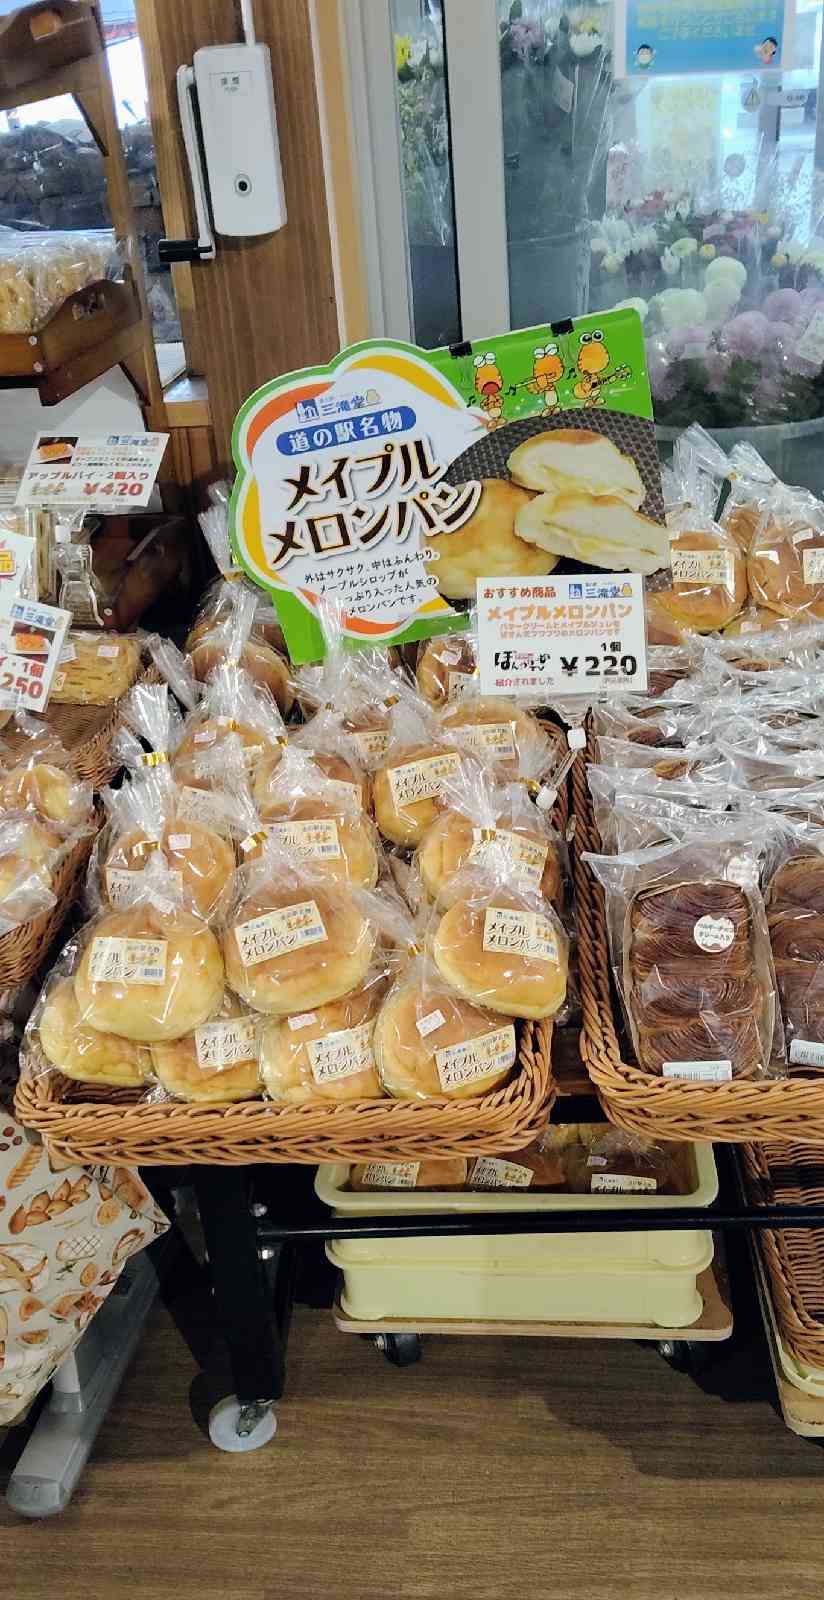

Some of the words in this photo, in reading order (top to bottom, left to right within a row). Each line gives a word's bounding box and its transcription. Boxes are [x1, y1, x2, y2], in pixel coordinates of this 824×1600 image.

[288, 410, 404, 453] 道の駅名物
[284, 440, 441, 511] メイプル
[269, 484, 482, 564] メロンパン
[345, 577, 437, 602] っぷり入った人気の
[483, 586, 557, 599] おすすめ商品
[487, 602, 632, 621] メイプルメロンパン
[600, 641, 621, 652] 1個
[560, 655, 637, 677] ¥220
[241, 927, 277, 946] メイプル
[489, 921, 527, 937] メイプル
[244, 934, 297, 959] メロンパン
